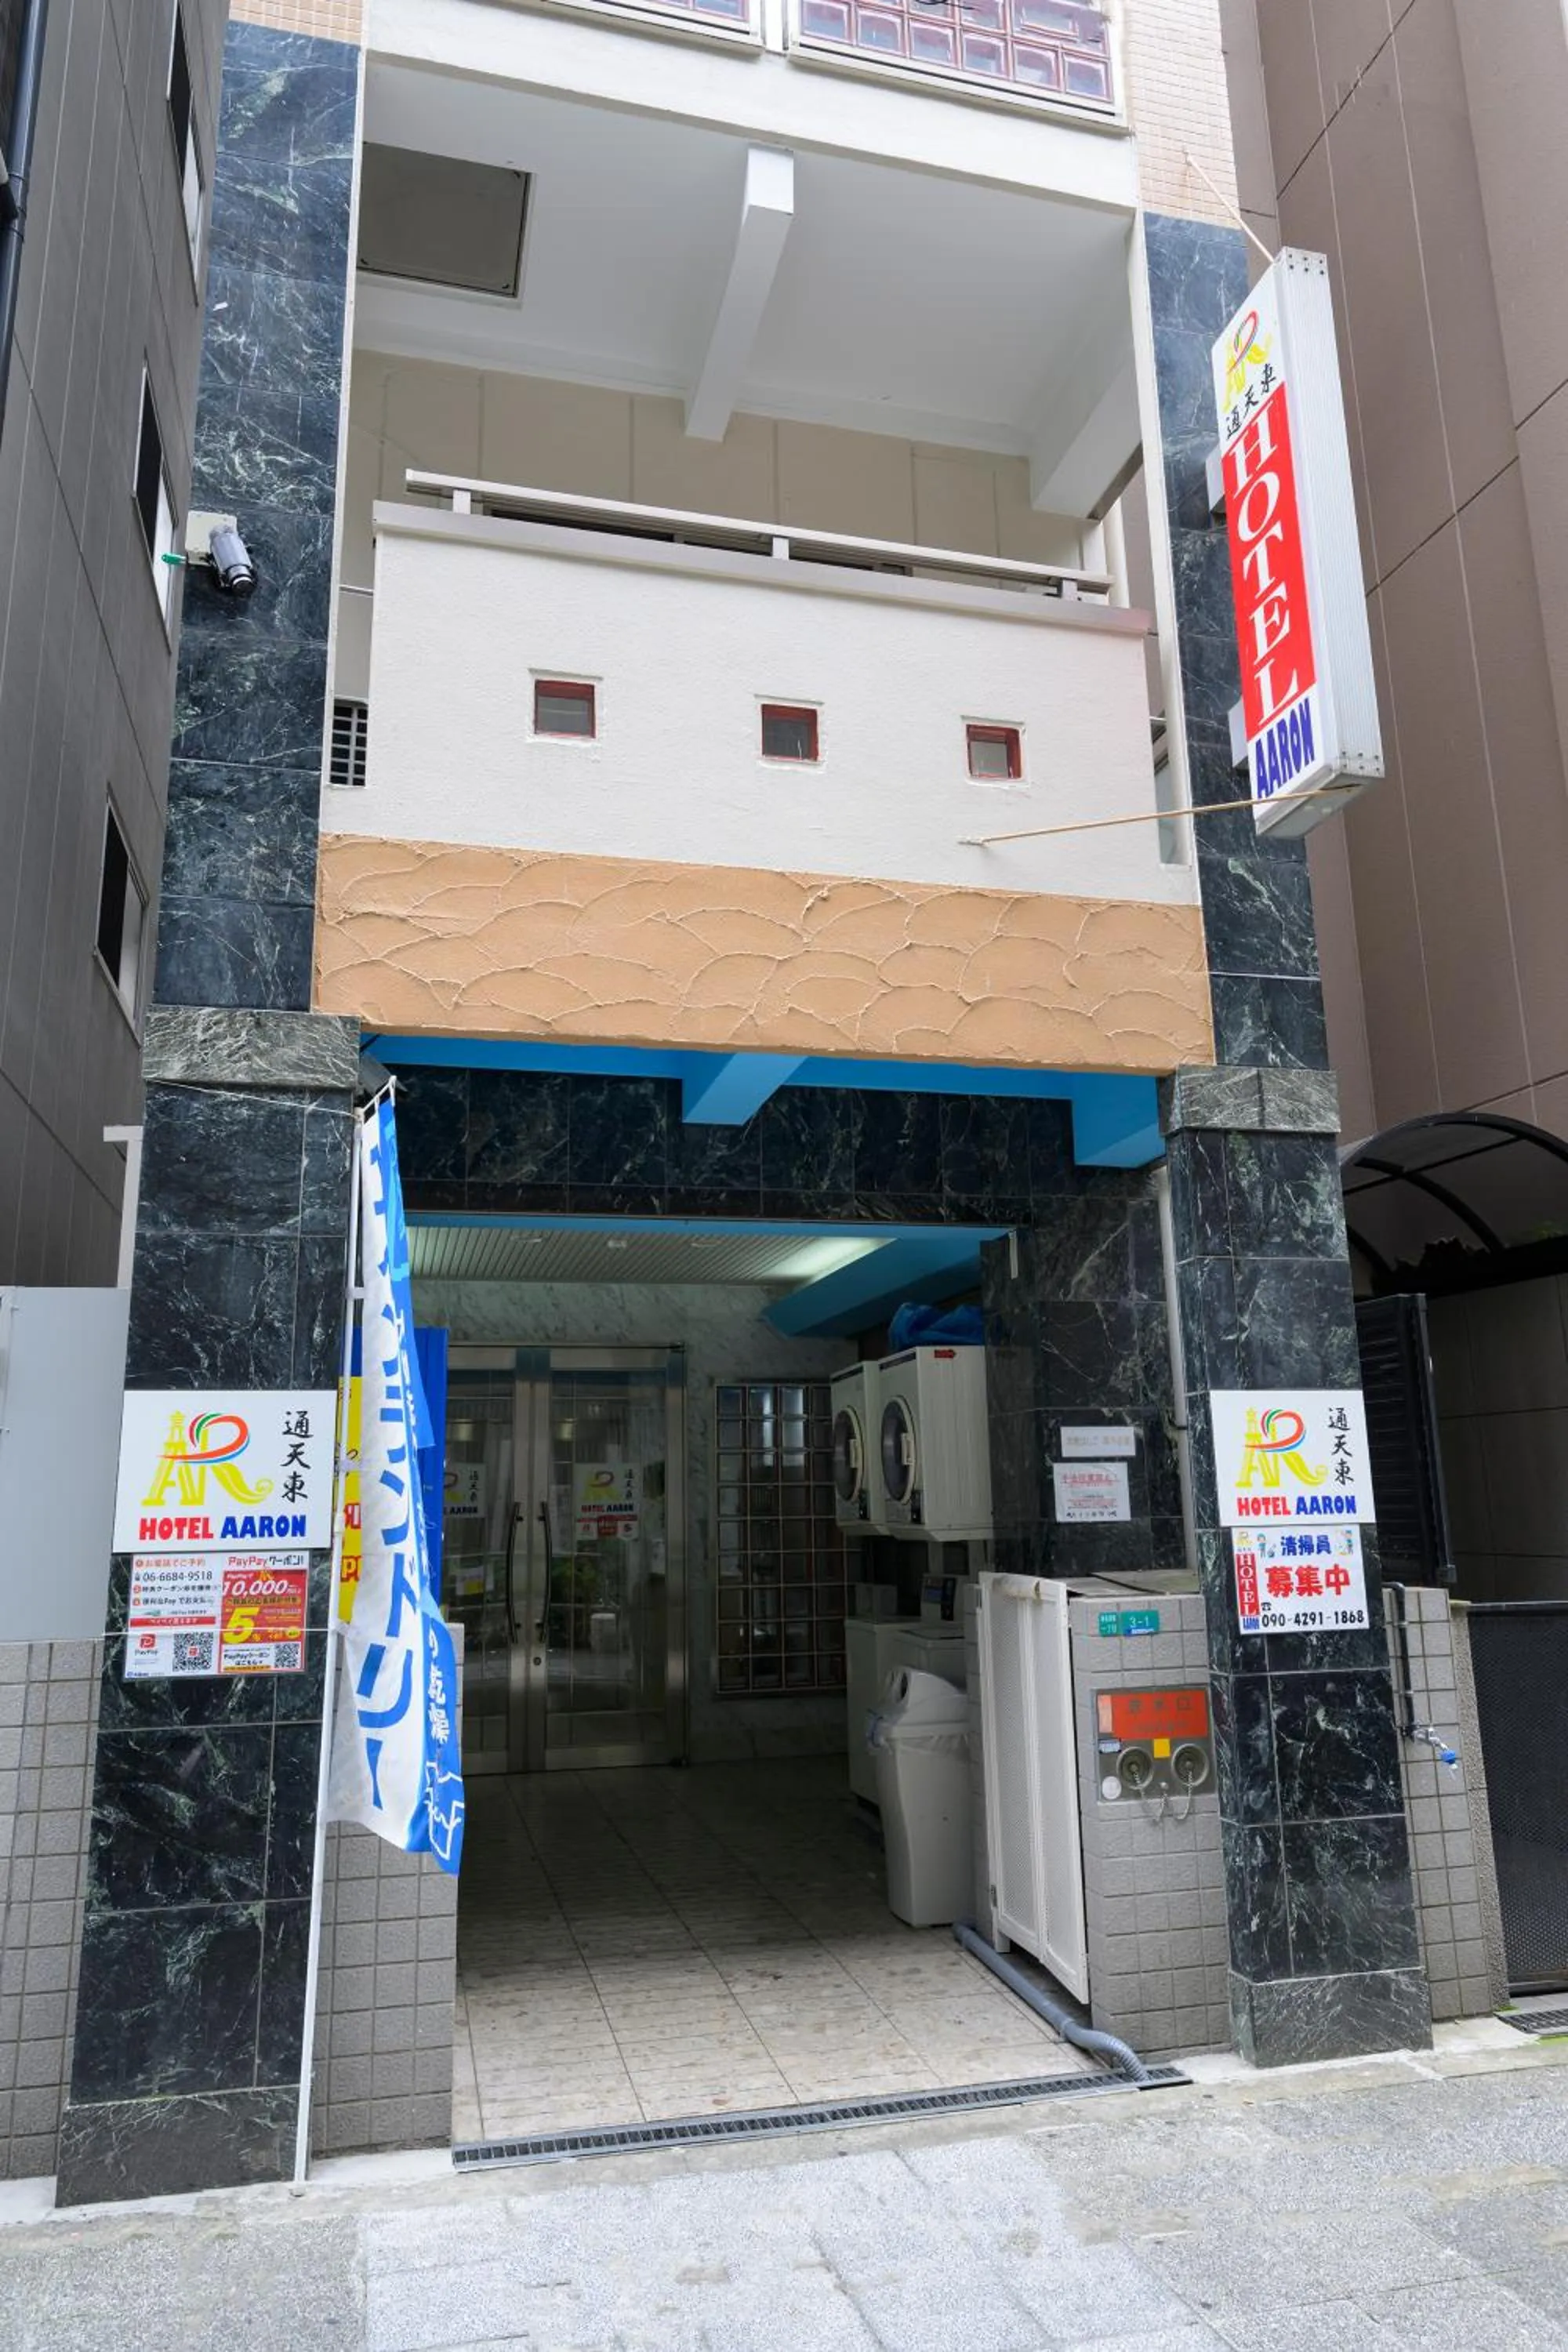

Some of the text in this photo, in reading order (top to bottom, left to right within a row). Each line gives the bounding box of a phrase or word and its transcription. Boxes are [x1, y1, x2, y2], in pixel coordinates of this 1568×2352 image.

[1229, 401, 1299, 730] HOTEL
[1256, 695, 1315, 800] AARON
[280, 1410, 314, 1504] 通天東
[1328, 1407, 1355, 1486] 通天東
[1236, 1495, 1357, 1517] HOTEL AARON
[138, 1515, 307, 1541] HOTEL AARON
[1280, 1535, 1332, 1556] 清掃員
[142, 1570, 213, 1582] 06-6684-9518
[223, 1580, 289, 1598] 10,000
[1239, 1554, 1259, 1615] HOTEL
[1265, 1563, 1351, 1598] 募集中
[1261, 1610, 1365, 1628] 090-4291-1868
